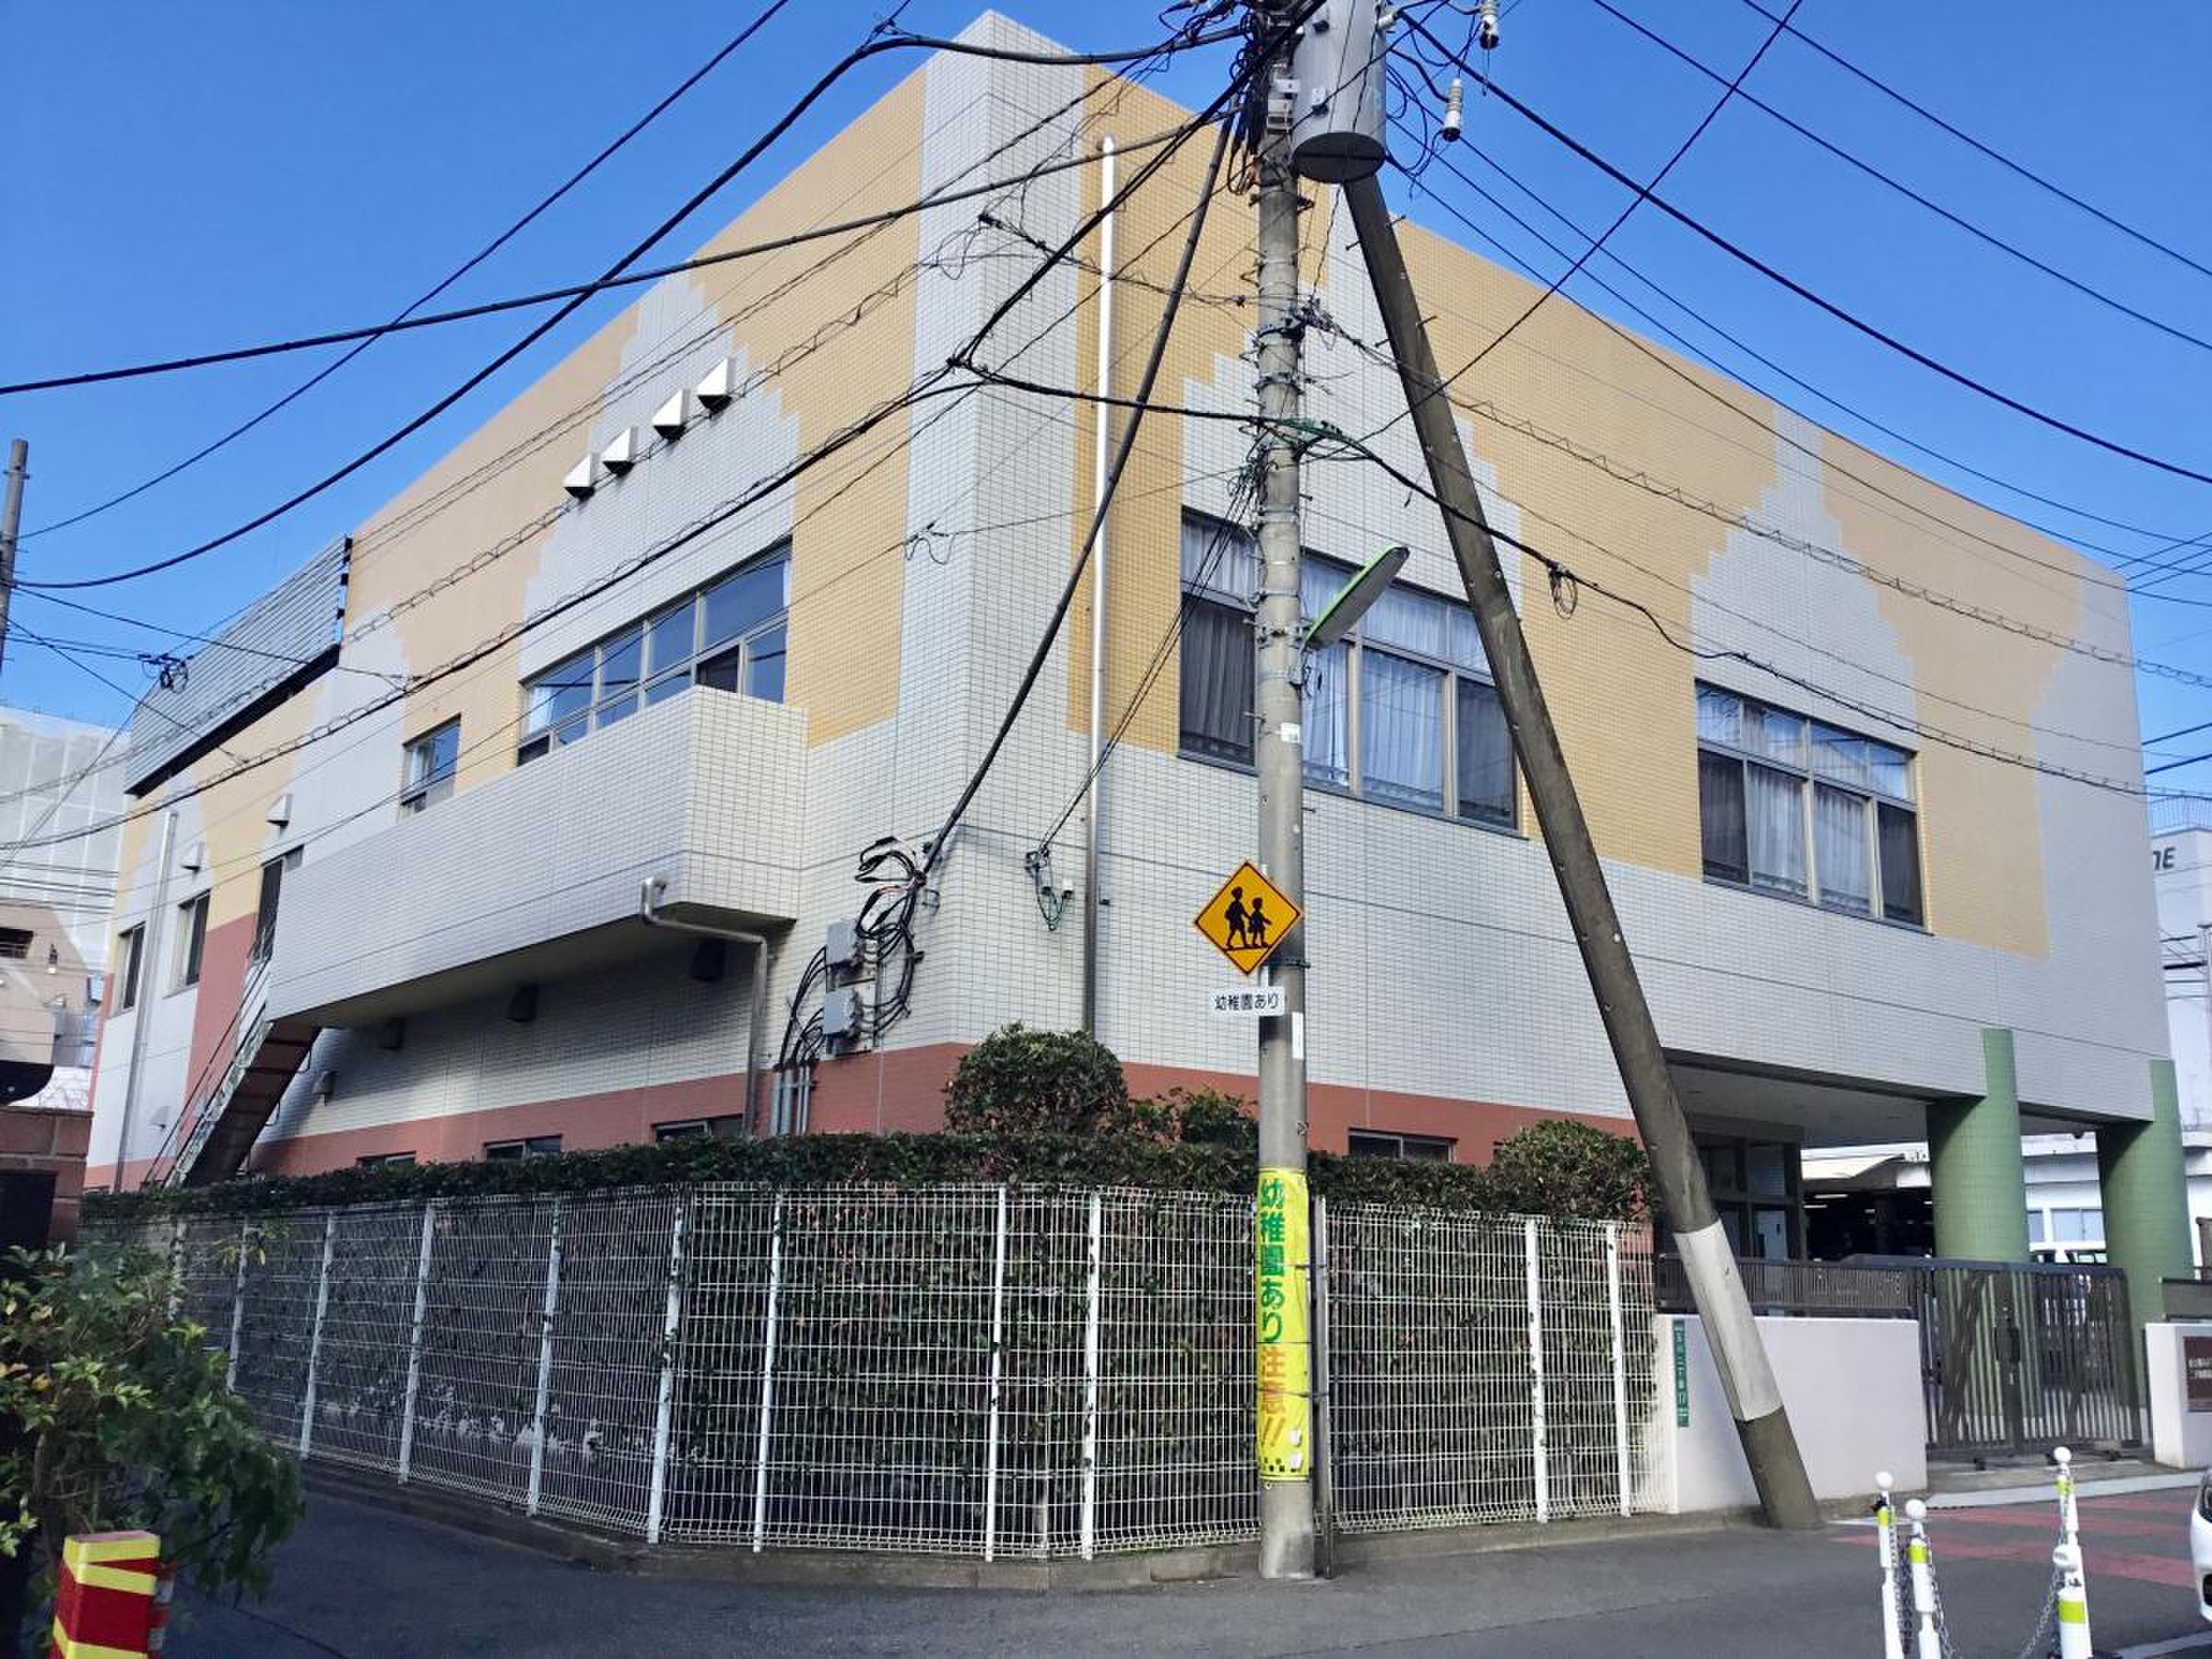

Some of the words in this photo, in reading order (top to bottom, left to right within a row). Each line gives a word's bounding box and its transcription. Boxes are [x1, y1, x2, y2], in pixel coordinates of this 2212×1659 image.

[1215, 994, 1278, 1011] 幼稚園あり
